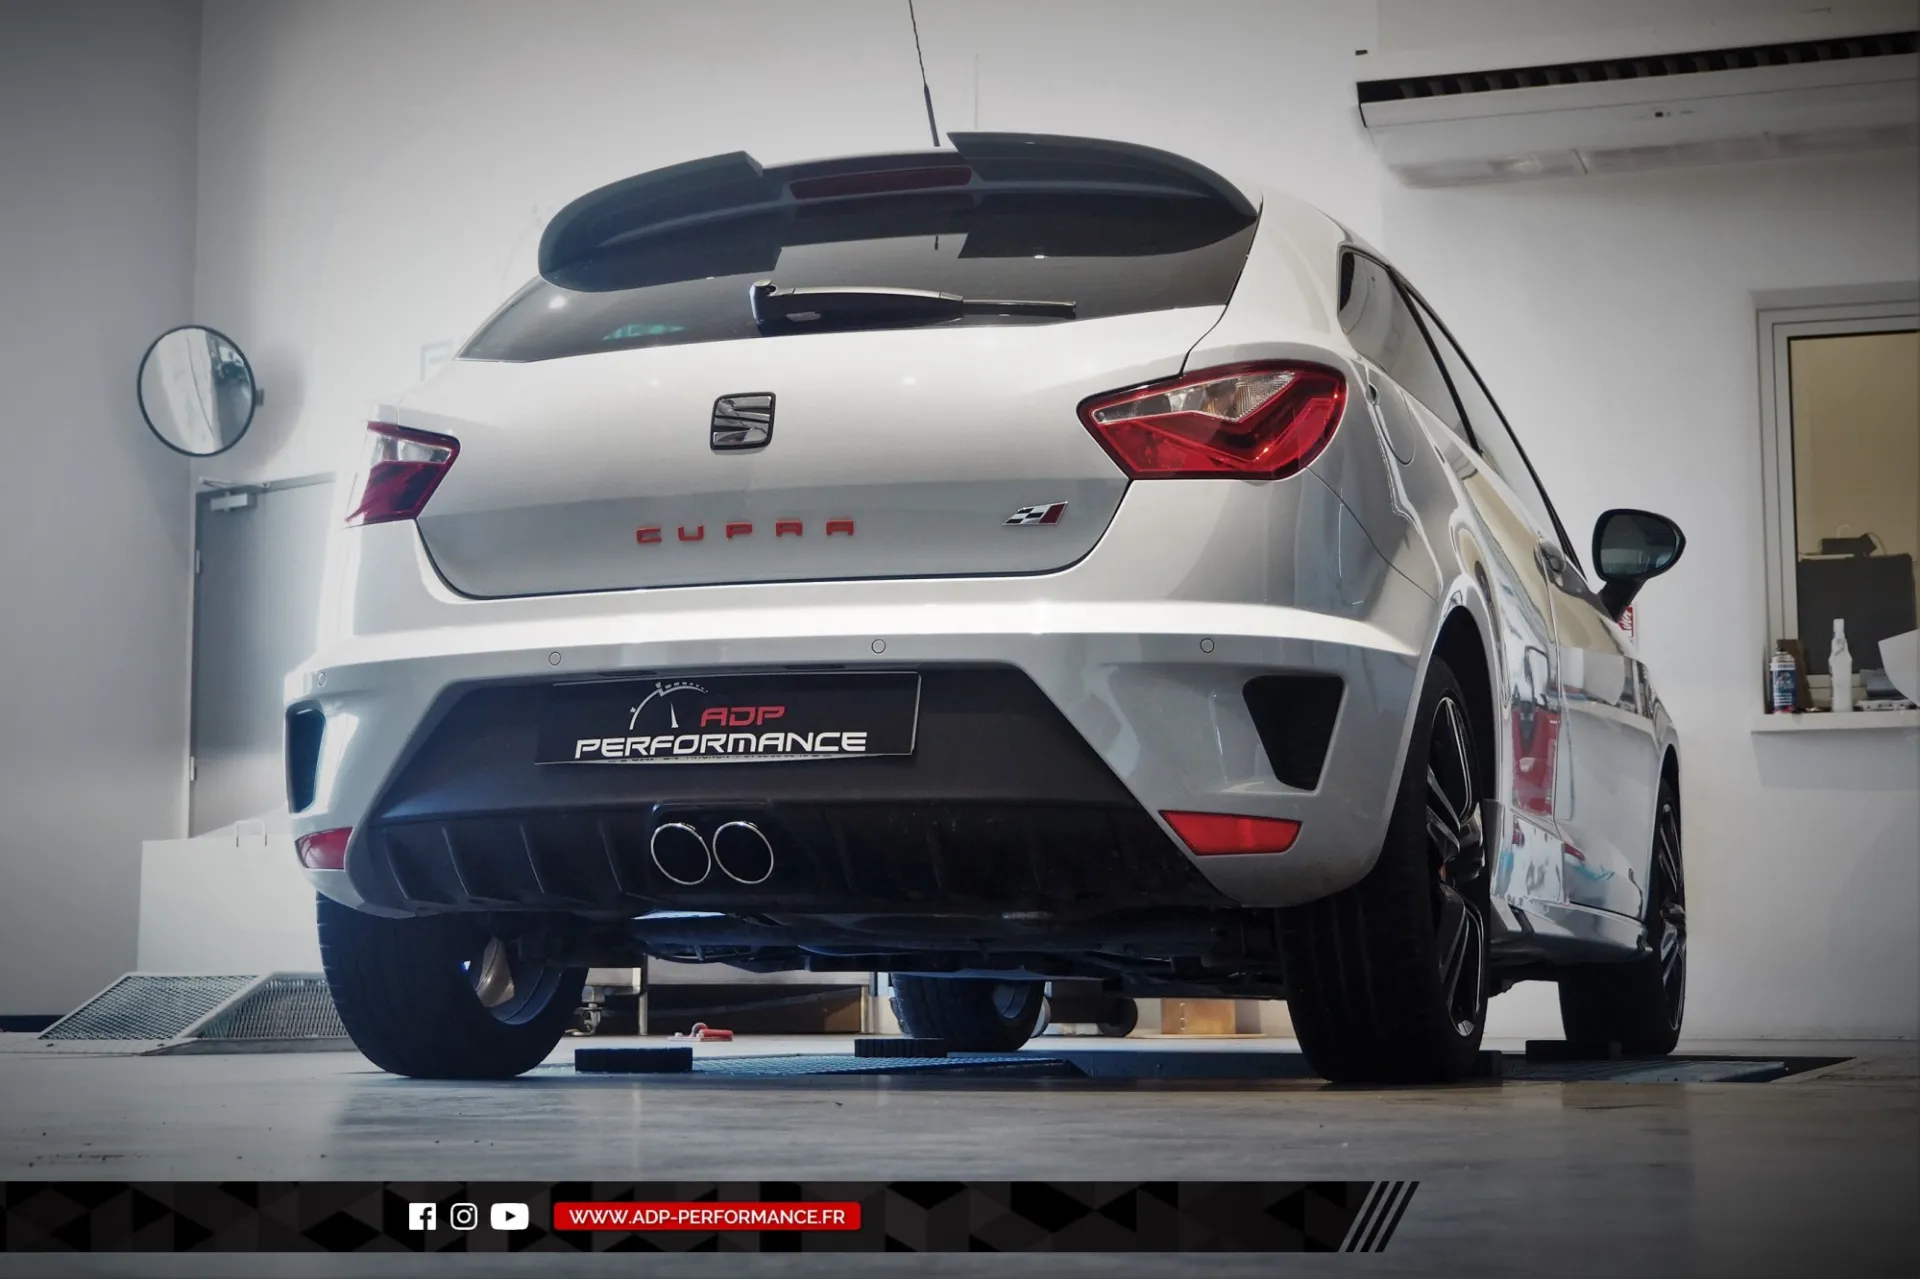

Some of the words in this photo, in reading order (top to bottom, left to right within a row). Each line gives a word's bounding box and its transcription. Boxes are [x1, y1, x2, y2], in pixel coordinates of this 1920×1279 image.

[637, 519, 854, 544] CUPRA
[701, 707, 785, 727] ADP
[575, 732, 867, 759] PERFORMANCE
